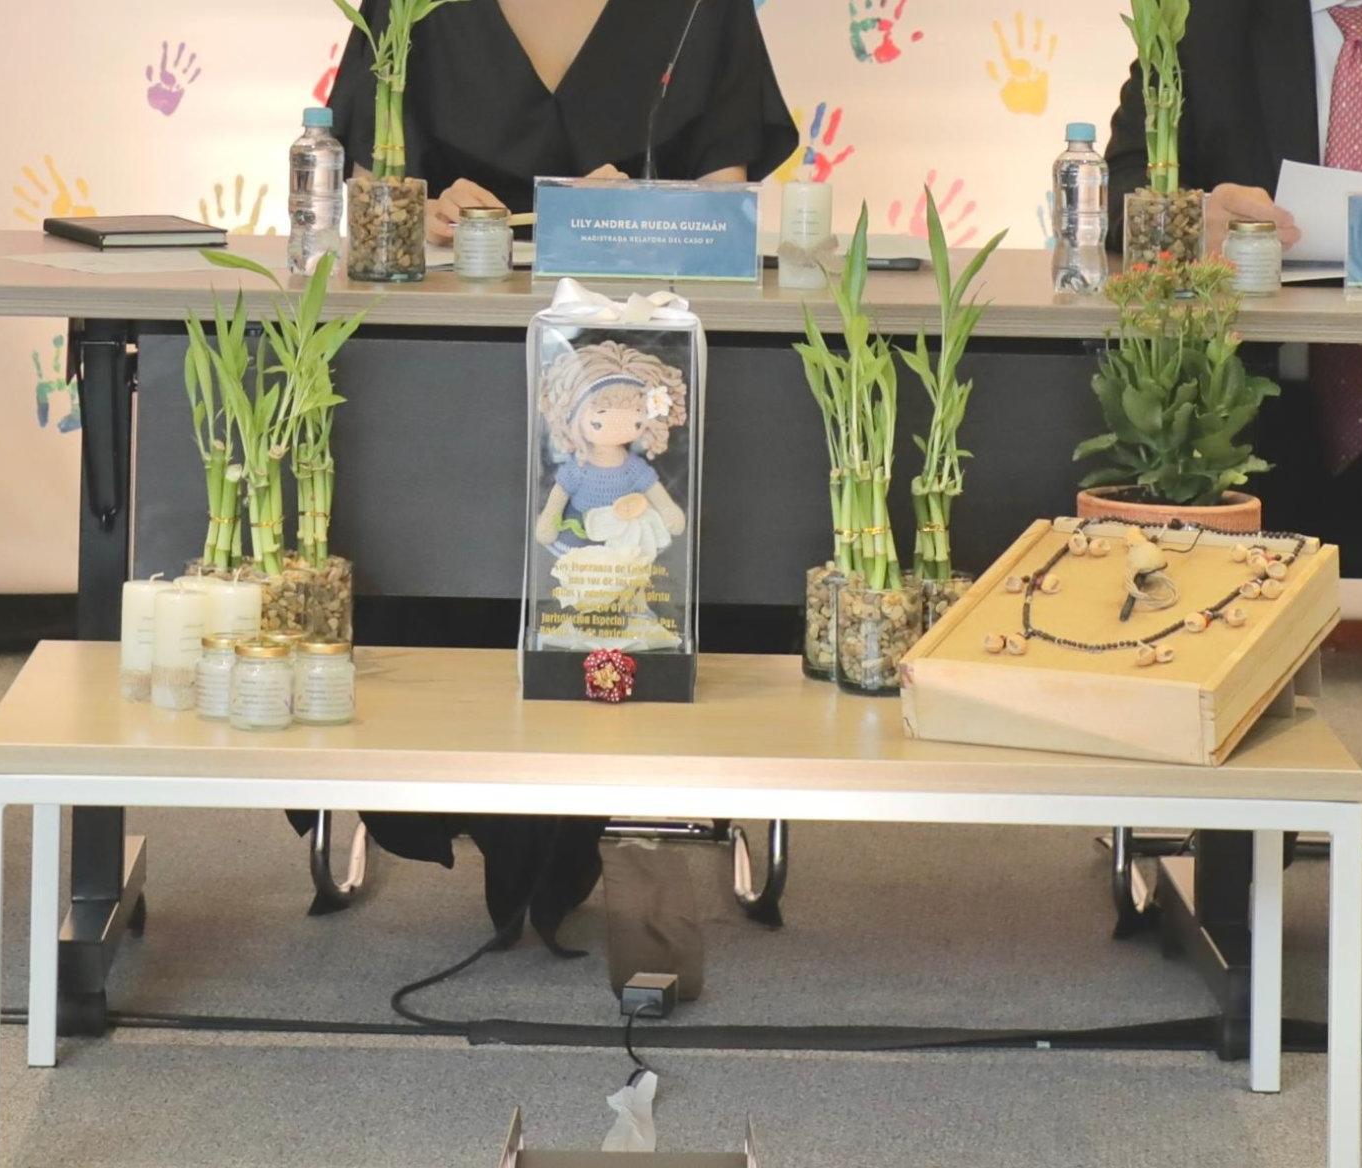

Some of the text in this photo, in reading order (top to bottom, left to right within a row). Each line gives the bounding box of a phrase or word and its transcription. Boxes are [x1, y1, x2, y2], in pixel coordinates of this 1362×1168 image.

[571, 219, 727, 232] LILY ANDREA RUEDA GUZMÁN
